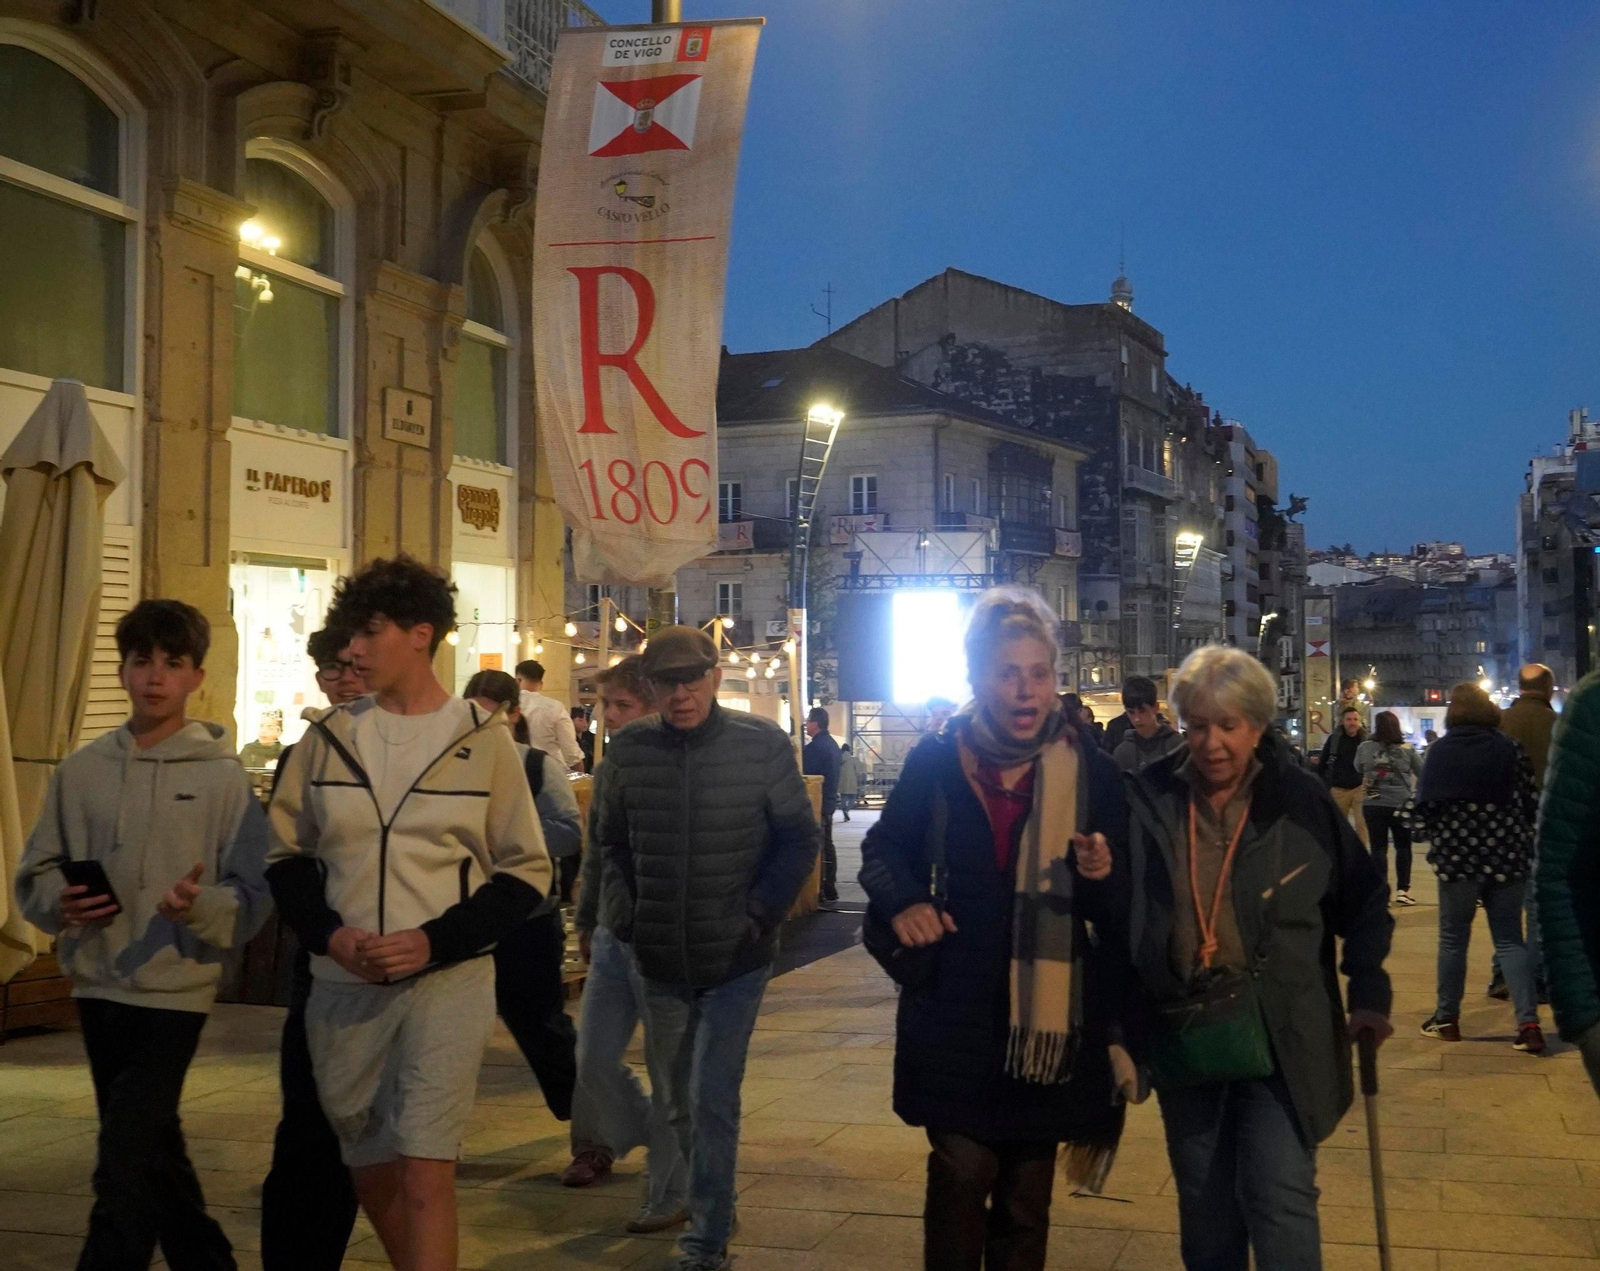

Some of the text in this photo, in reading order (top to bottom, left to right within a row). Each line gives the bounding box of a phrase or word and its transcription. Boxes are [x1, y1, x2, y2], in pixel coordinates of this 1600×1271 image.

[609, 35, 672, 48] CONCELLO
[614, 47, 662, 59] DE VIGO
[566, 265, 706, 438] R
[246, 468, 320, 498] IL PAPERO
[578, 458, 711, 525] 1809
[1308, 710, 1330, 735] R
